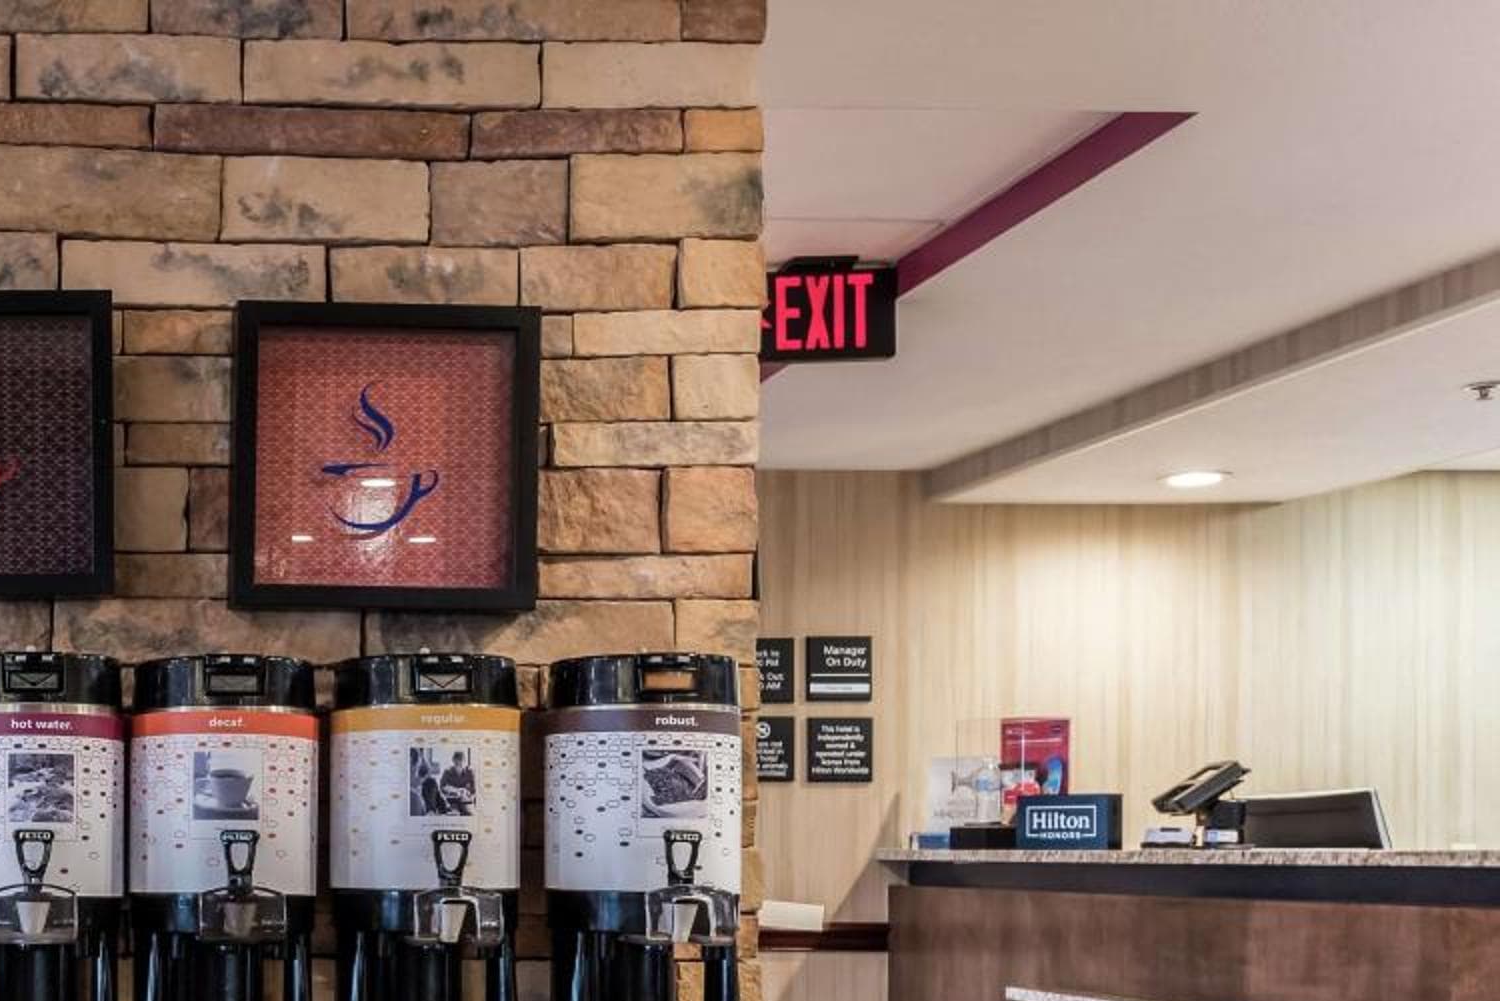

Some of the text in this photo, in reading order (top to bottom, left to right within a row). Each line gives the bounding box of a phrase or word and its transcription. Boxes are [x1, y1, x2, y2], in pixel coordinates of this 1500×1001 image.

[775, 273, 873, 350] EXIT
[823, 645, 867, 657] Manager
[825, 657, 867, 668] On Duty
[11, 718, 73, 730] hot water.
[209, 716, 244, 728] decaf.
[655, 714, 699, 727] robust.
[1031, 811, 1090, 830] Hilton
[19, 831, 51, 840] FETCO
